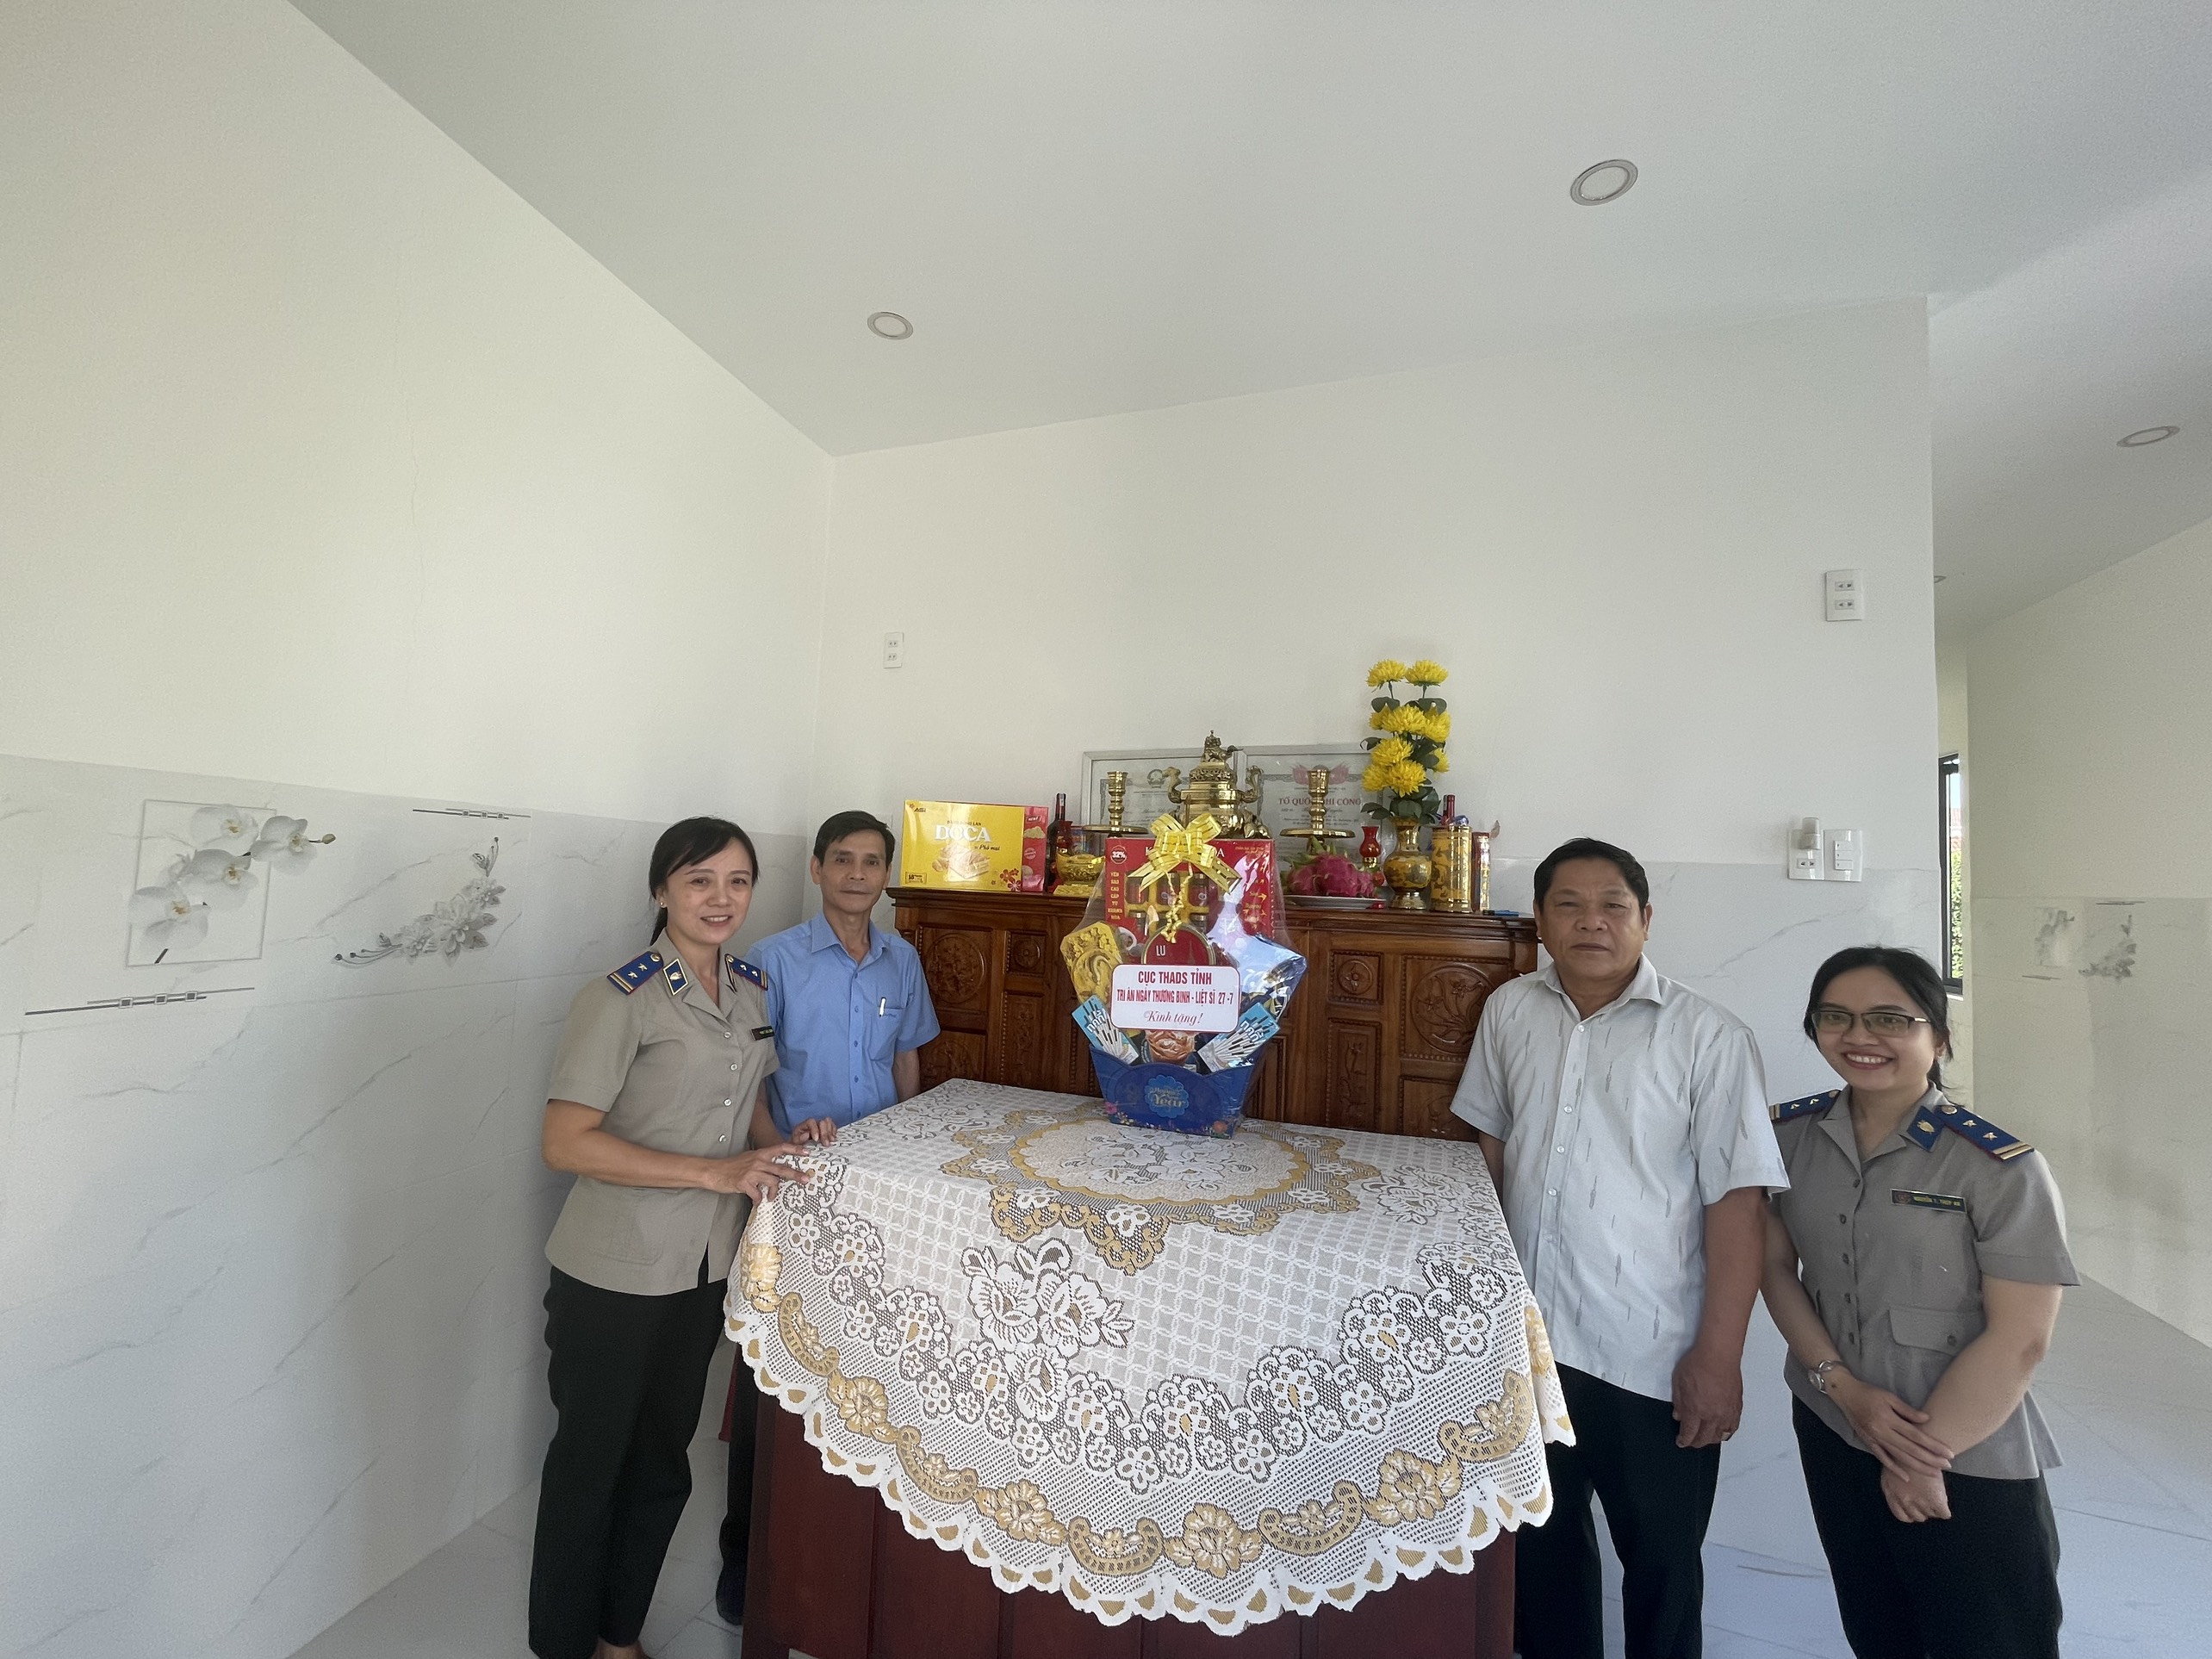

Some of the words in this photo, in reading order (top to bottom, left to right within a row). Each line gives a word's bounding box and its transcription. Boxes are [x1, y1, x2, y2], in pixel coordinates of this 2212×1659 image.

[934, 823, 992, 842] DOCA
[1111, 850, 1126, 859] 32%
[1156, 945, 1166, 957] LU
[1138, 970, 1156, 986] CỤC
[1159, 971, 1188, 985] THADS
[1191, 968, 1212, 985] TỈNH
[1116, 989, 1126, 1002] TRI
[1127, 986, 1135, 1002] ÂN
[1135, 987, 1152, 1003] NGÀY
[1176, 991, 1190, 1003] BINH
[1195, 989, 1208, 1007] LIỆT
[1209, 989, 1215, 1004] SĨ
[1218, 991, 1227, 1005] 27
[1143, 1010, 1172, 1022] Kính
